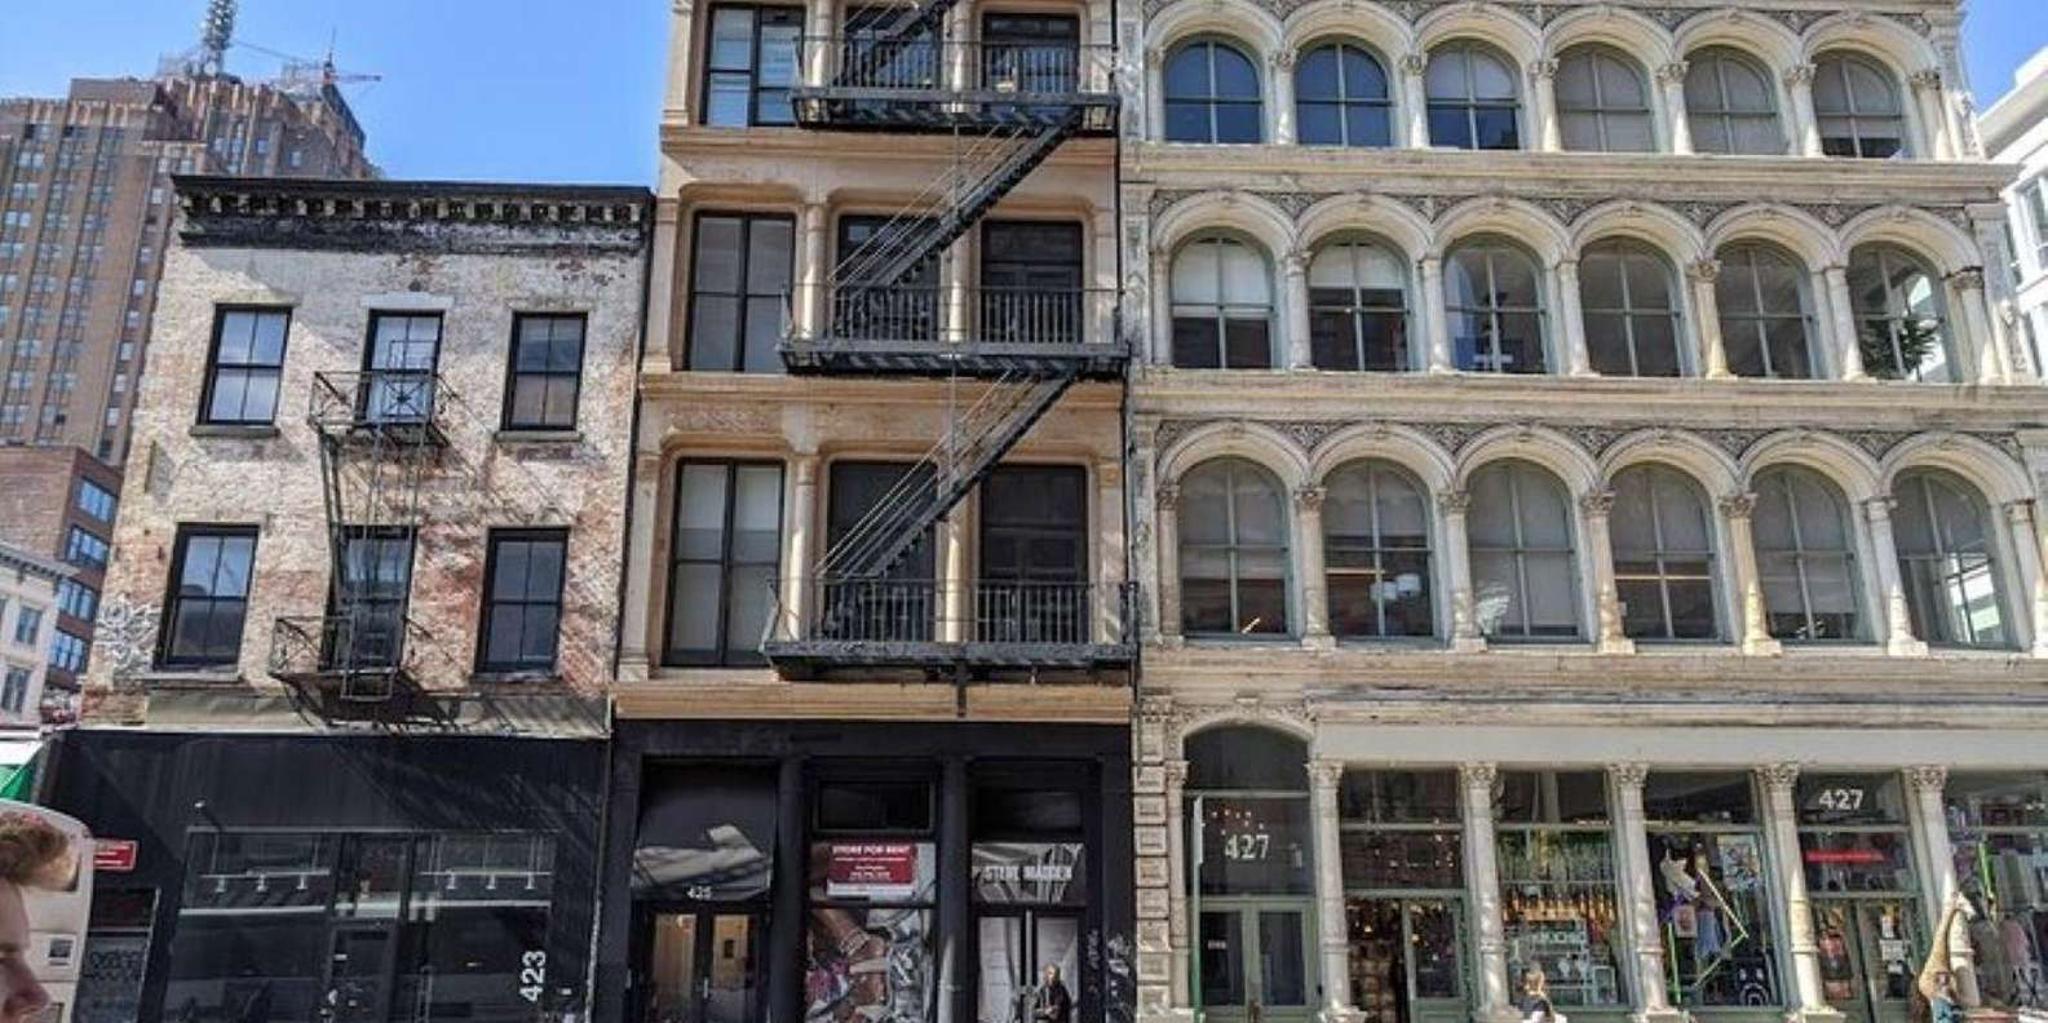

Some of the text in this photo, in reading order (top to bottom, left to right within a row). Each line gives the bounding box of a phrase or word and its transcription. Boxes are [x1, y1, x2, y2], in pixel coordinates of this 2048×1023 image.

[1819, 789, 1863, 810] 427
[864, 845, 883, 855] FOR
[1224, 834, 1269, 859] 427
[519, 951, 546, 1002] 423
